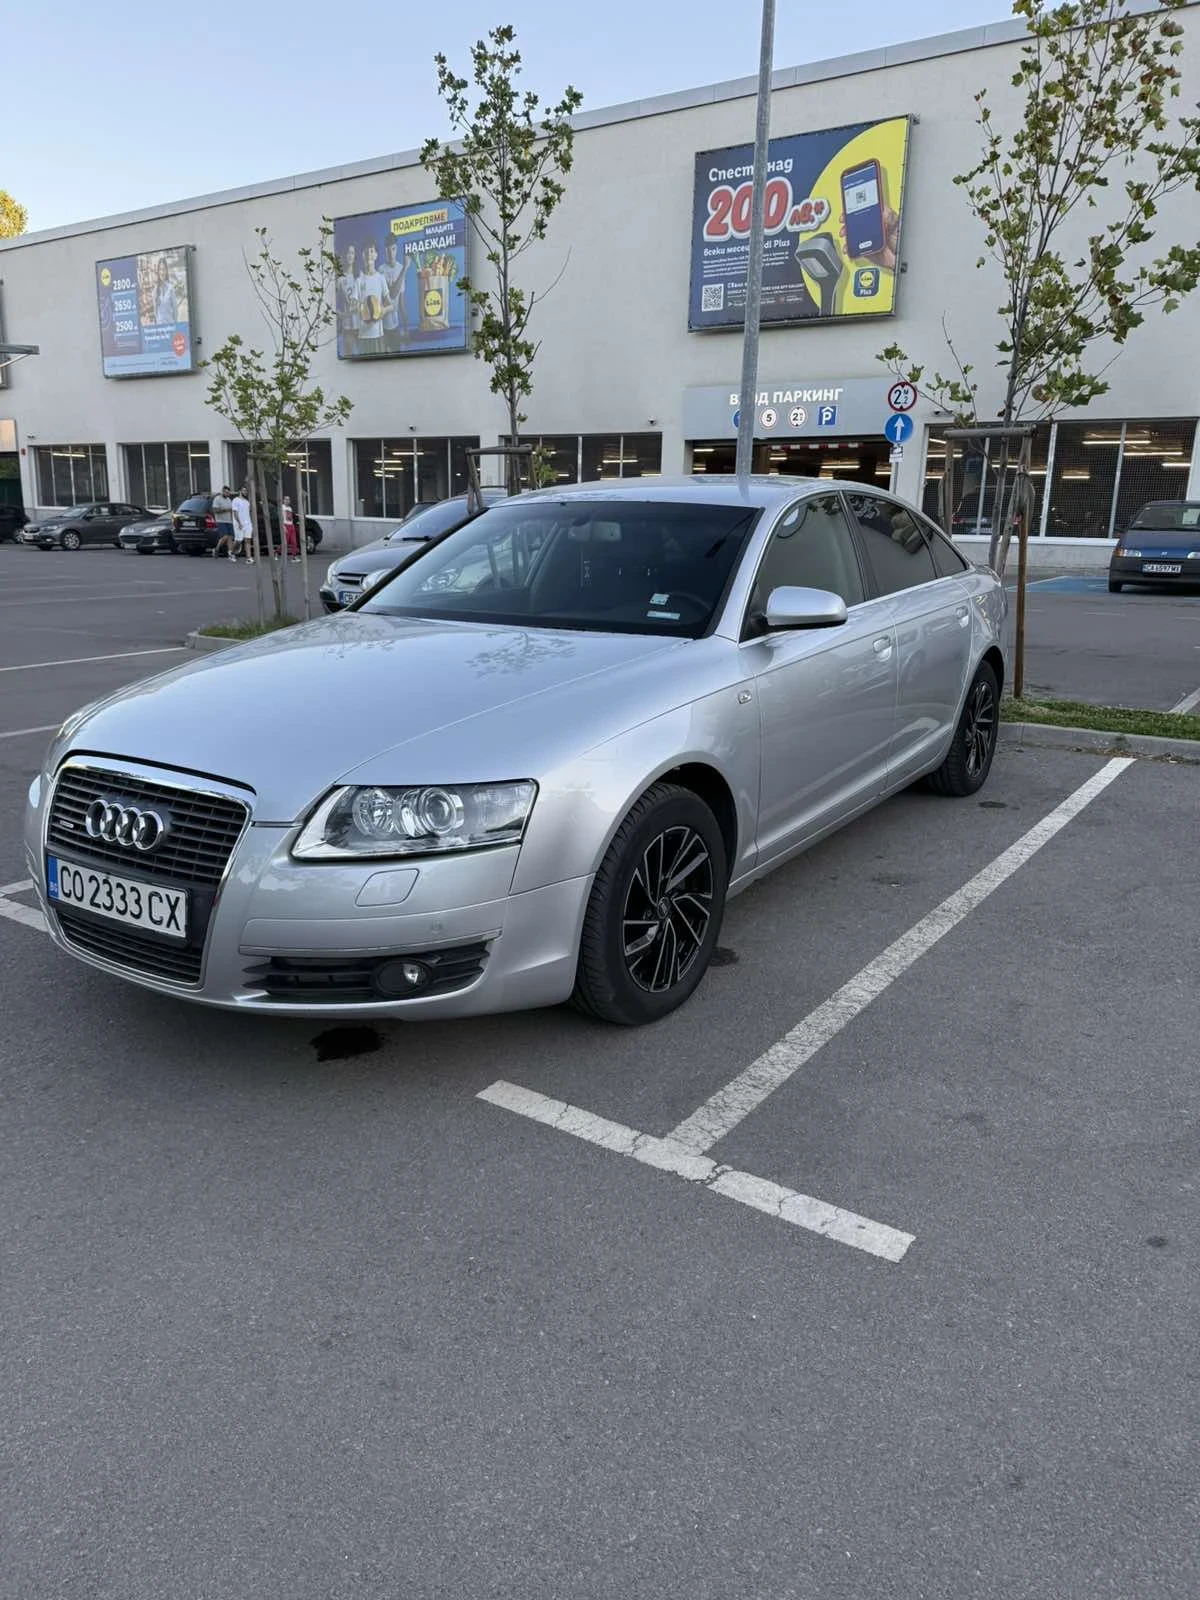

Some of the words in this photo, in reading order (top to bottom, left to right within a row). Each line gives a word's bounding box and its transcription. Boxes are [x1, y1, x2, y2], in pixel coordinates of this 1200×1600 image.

[708, 164, 754, 182] Спест
[767, 159, 793, 173] над
[705, 179, 790, 237] 200
[393, 211, 446, 232] ПОДКРЕПЯМЕ
[425, 223, 454, 235] МЛАДИТЕ
[404, 234, 456, 254] НАДЕЖДИ!
[773, 239, 790, 248] Plus
[773, 388, 844, 404] ПАРКИНГ
[88, 875, 143, 920] 2333
